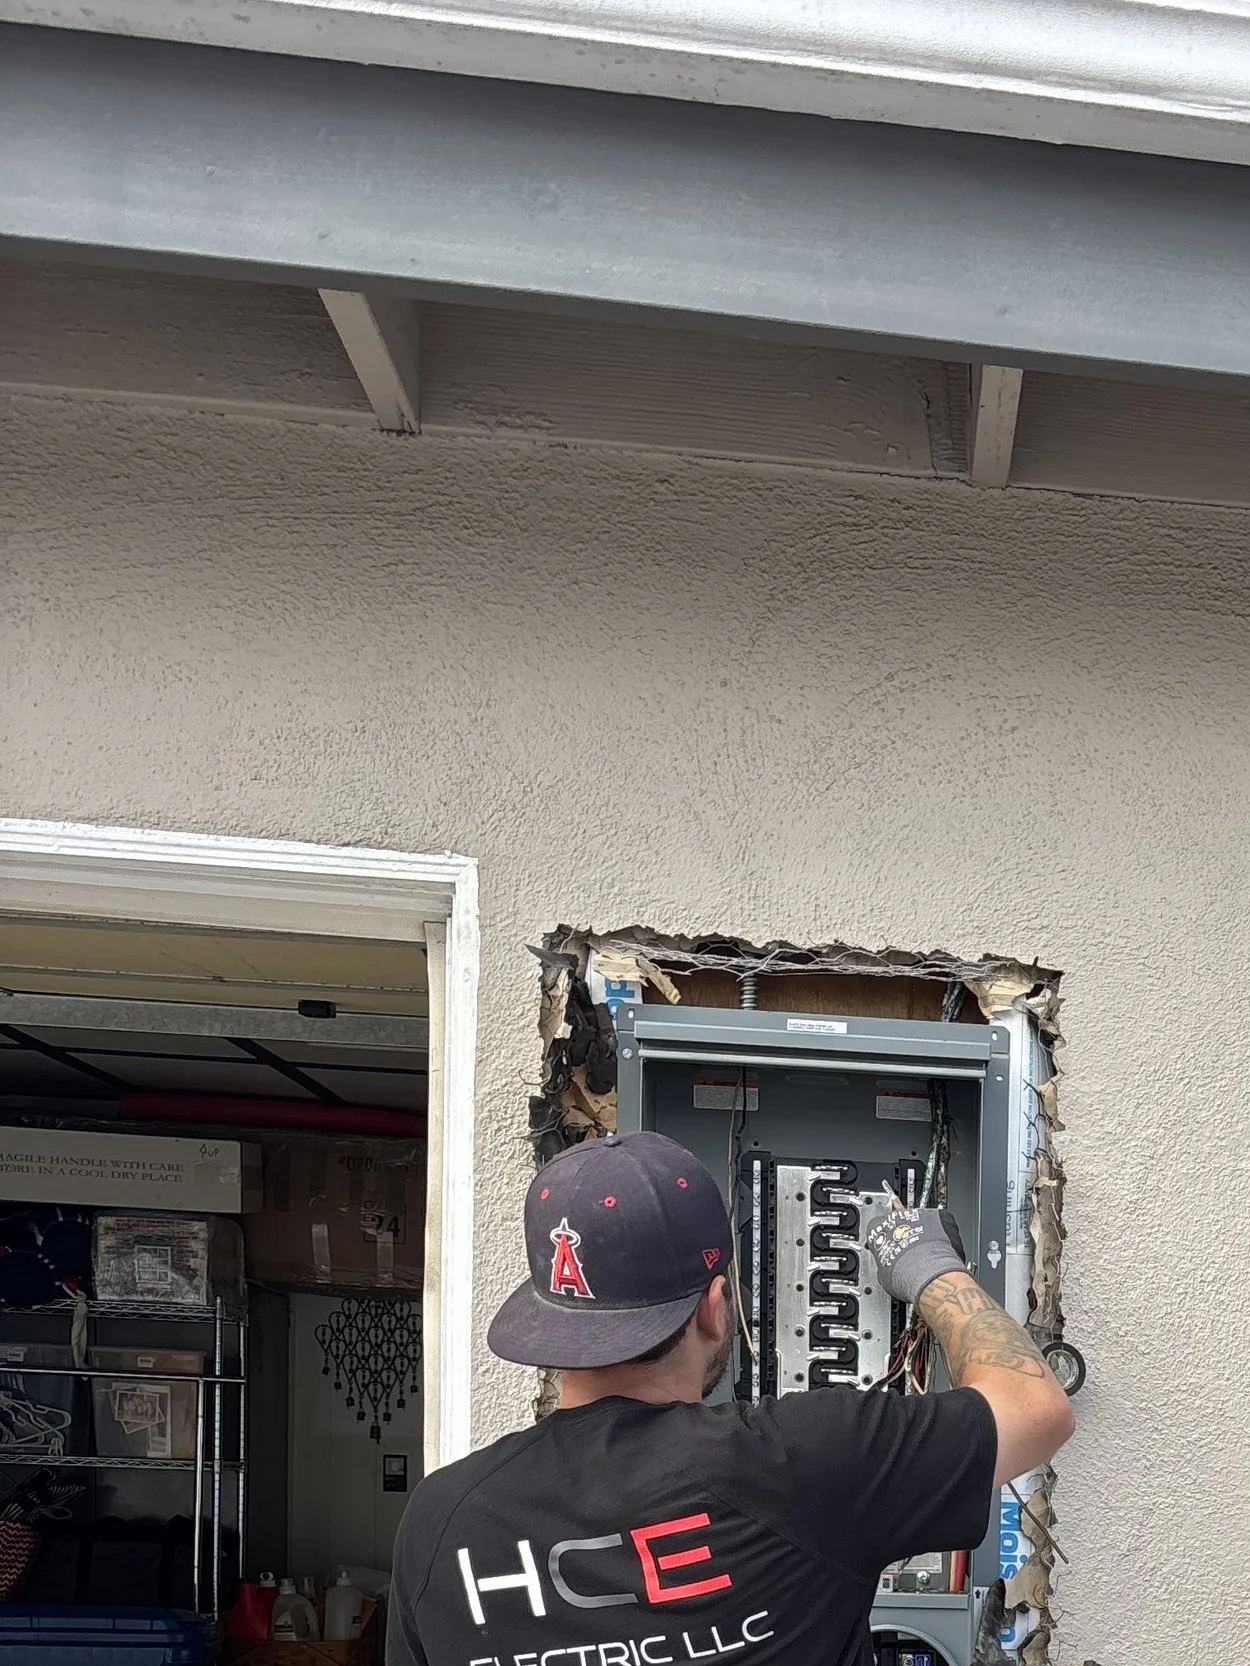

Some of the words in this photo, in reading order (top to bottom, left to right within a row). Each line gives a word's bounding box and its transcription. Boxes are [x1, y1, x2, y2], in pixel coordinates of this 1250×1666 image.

[38, 1166, 53, 1175] IN
[58, 1168, 66, 1176] A
[69, 1168, 108, 1179] COOL
[111, 1171, 138, 1181] DRY
[142, 1173, 184, 1183] PLACE
[50, 1157, 107, 1168] HANDLE
[111, 1159, 149, 1170] WITH
[150, 1162, 184, 1173] CARE
[550, 1217, 596, 1299] A
[457, 1512, 733, 1625] HCE
[682, 1610, 774, 1659] LLC
